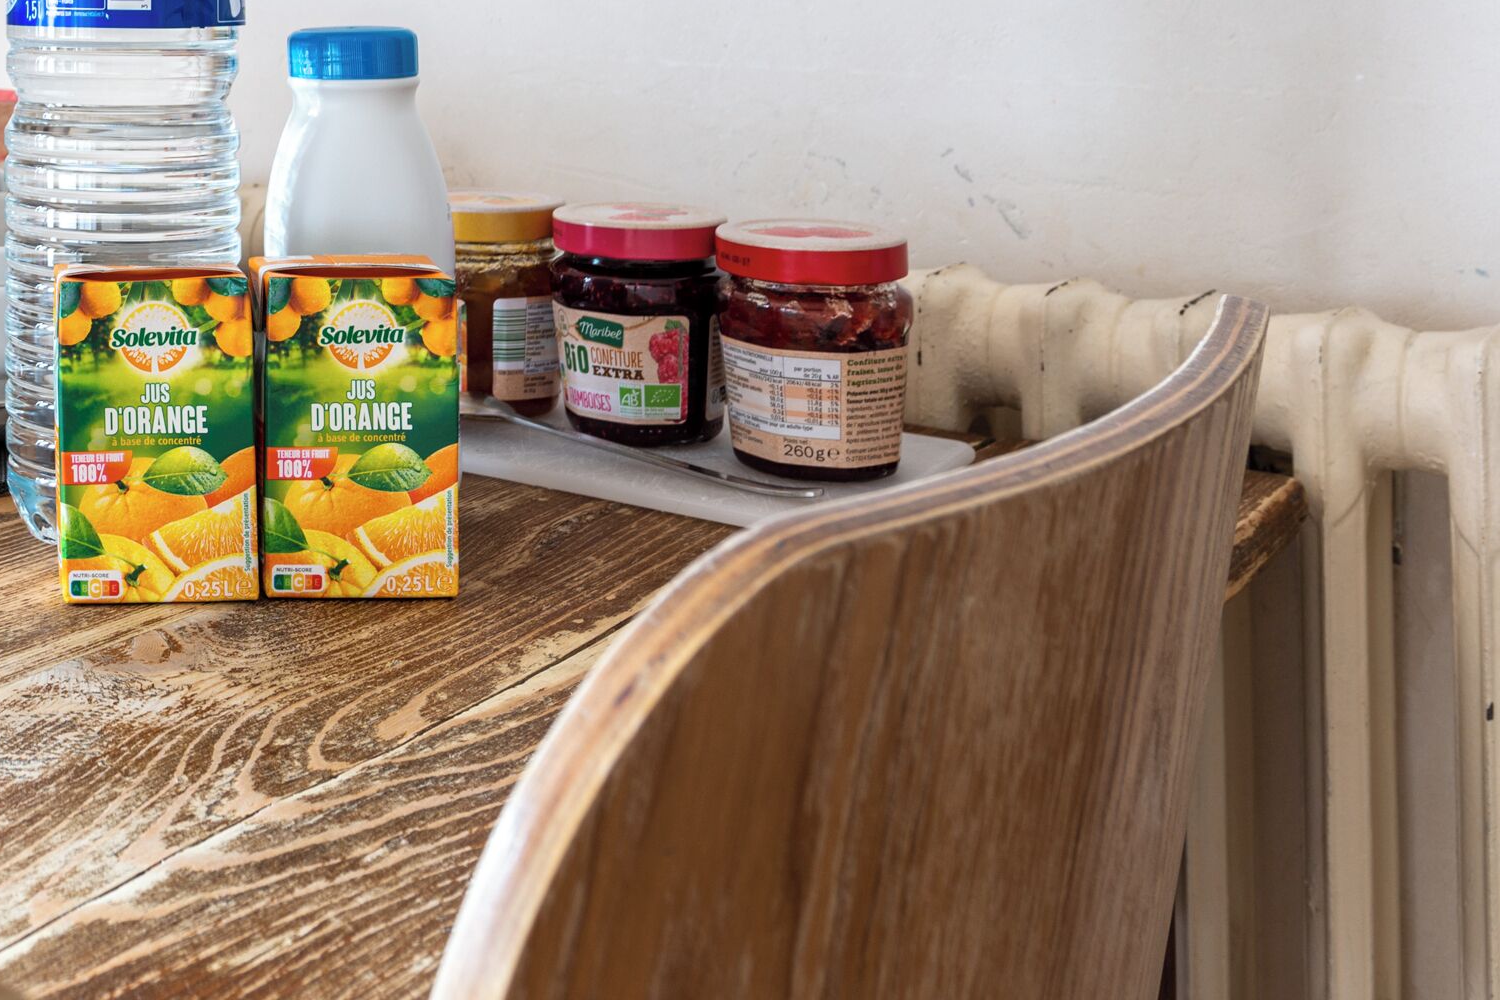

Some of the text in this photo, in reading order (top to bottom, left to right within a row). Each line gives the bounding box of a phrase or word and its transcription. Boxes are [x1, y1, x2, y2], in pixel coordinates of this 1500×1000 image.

[111, 326, 196, 347] Solevita
[320, 324, 404, 345] Solevita
[580, 322, 622, 340] Maribel
[590, 347, 644, 369] CONFITURE
[847, 358, 886, 366] Confiture
[592, 365, 644, 380] EXTRA
[140, 383, 170, 404] JUS
[347, 380, 376, 400] JUS
[104, 406, 208, 435] D'ORANGE
[311, 402, 413, 431] D'ORANGE
[112, 435, 202, 446] à base de concentré
[317, 432, 406, 442] à base de concentré
[71, 453, 124, 463] TENEUR EN FRUIT
[277, 449, 330, 458] TENEUR EN FRUIT
[71, 463, 107, 483] 100%
[277, 459, 312, 478] 100%
